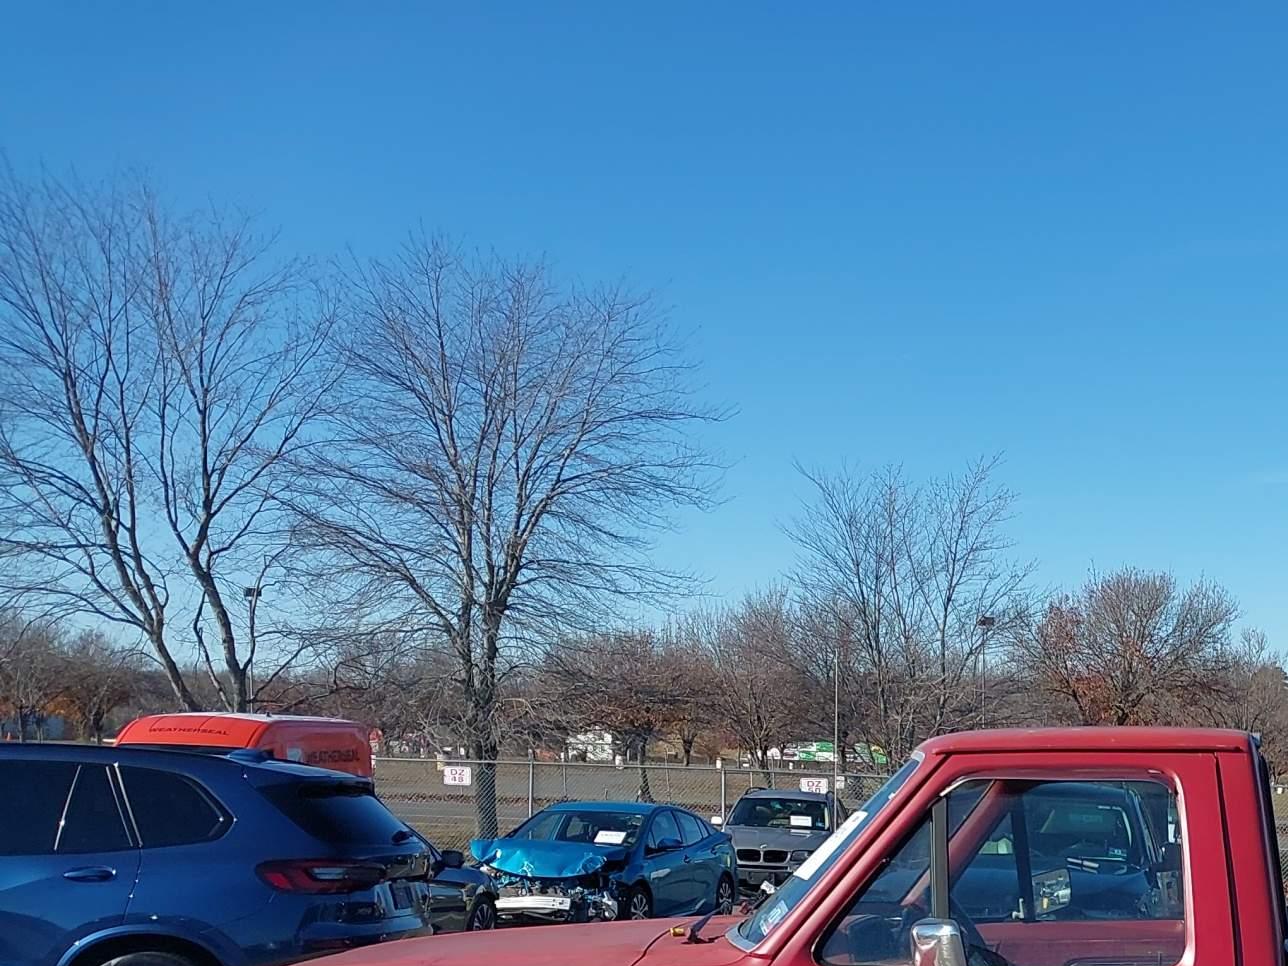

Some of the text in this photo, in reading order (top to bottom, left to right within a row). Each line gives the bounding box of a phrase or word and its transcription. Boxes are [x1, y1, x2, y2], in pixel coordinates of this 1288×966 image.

[148, 726, 230, 736] WEATHERSEAL
[304, 748, 361, 764] WEATHERSEAL
[806, 780, 822, 788] DZ
